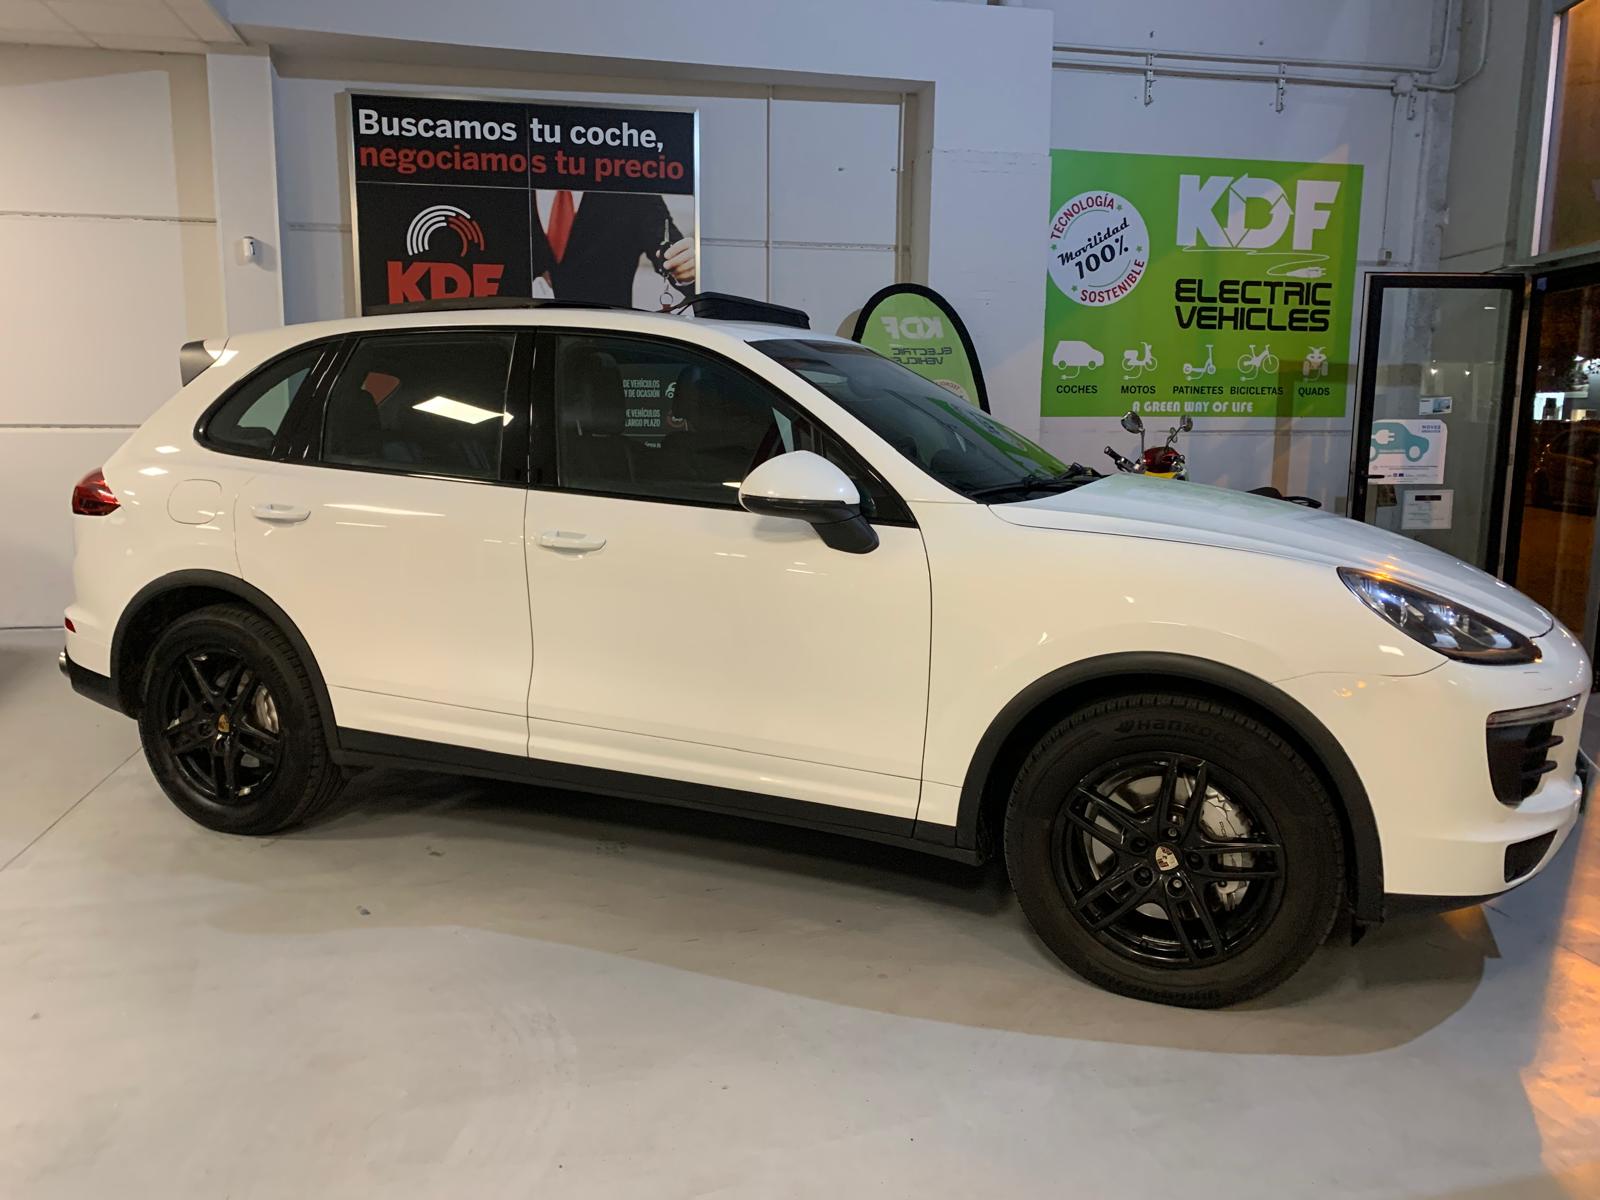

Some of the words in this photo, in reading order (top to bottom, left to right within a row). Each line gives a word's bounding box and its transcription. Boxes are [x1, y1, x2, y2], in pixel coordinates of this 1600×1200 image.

[358, 108, 518, 142] Buscamos
[530, 117, 561, 144] tu
[569, 122, 665, 153] coche,
[359, 145, 547, 175] negociamos
[555, 150, 585, 176] tu
[594, 154, 685, 182] precio
[1050, 193, 1116, 241] TECNOLOGÍA
[1176, 173, 1342, 251] KDF
[1057, 217, 1131, 267] Movilidad
[1074, 235, 1130, 281] 100%
[387, 260, 505, 305] KDF
[1080, 258, 1146, 304] SOSTENIBLE
[1175, 278, 1333, 307] ELECTRIC
[1174, 305, 1332, 332] VEHICLES
[1056, 385, 1098, 395] COCHES
[1120, 385, 1156, 395] MOTOS
[1172, 385, 1224, 396] PATINETES
[1229, 386, 1284, 397] BICICLETAS
[1297, 386, 1331, 397] QUADS
[1132, 401, 1141, 413] A
[1143, 401, 1181, 413] GREEN
[1183, 402, 1213, 413] WAY
[1214, 402, 1229, 412] OF
[1232, 402, 1254, 413] LIFE
